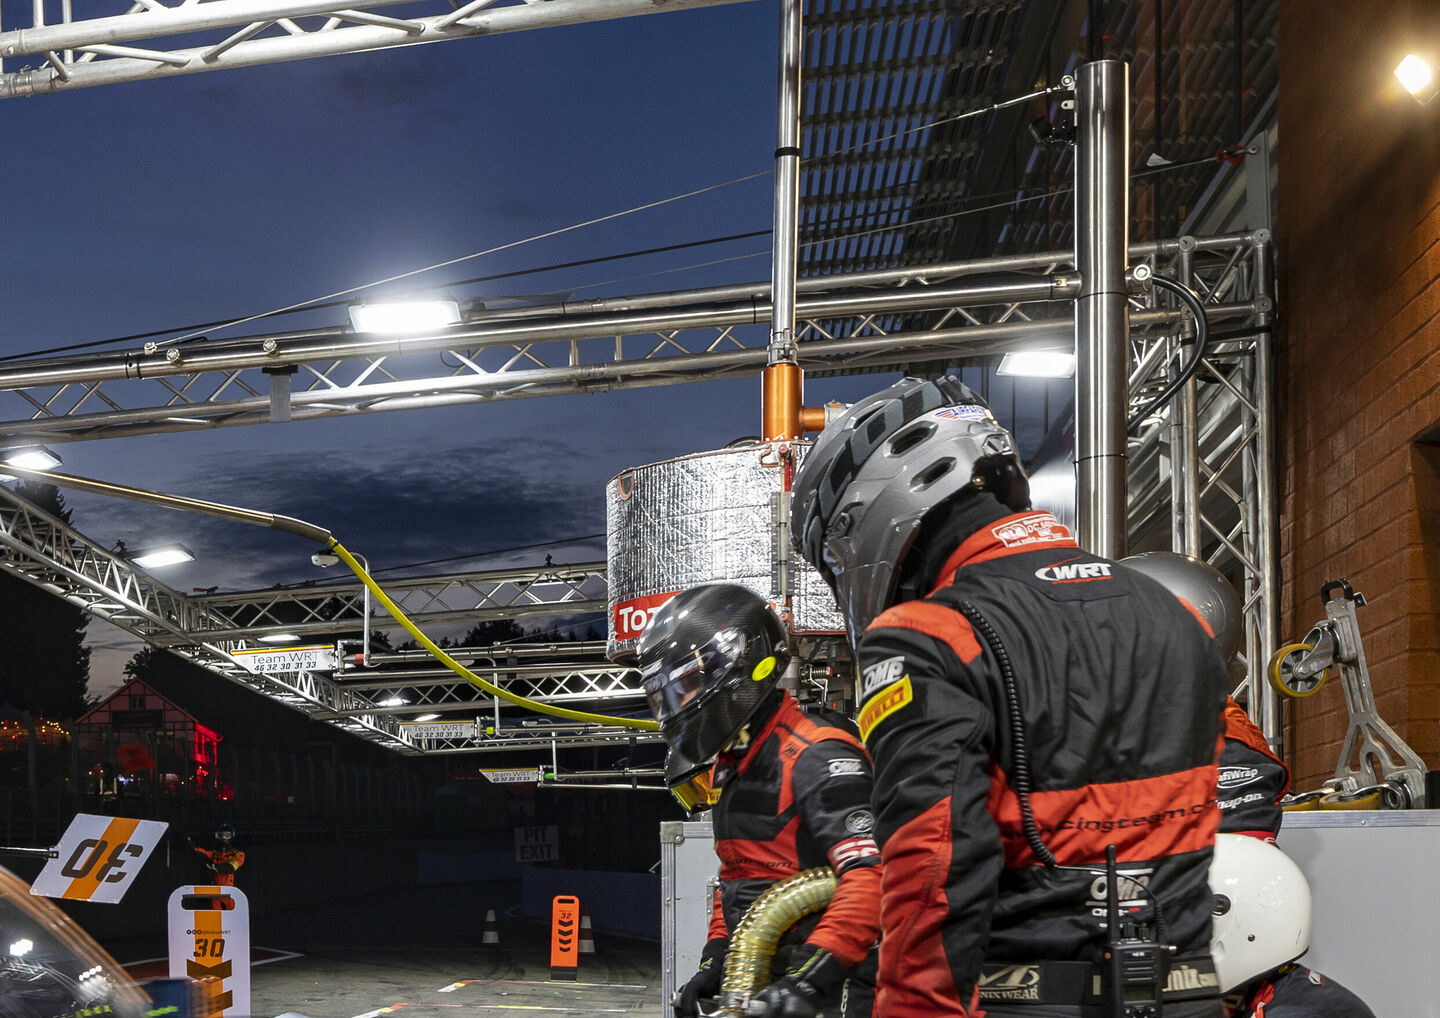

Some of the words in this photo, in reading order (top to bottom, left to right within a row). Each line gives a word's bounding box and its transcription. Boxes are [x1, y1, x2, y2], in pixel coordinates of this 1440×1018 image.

[1052, 562, 1112, 580] WRT
[251, 654, 286, 665] Team
[289, 651, 319, 662] WRT
[254, 664, 264, 672] 46
[267, 663, 277, 671] 32
[306, 661, 317, 669] 33
[864, 660, 904, 692] OMP
[524, 827, 548, 843] PIT
[60, 838, 144, 884] 30
[520, 844, 553, 861] EXIT
[193, 938, 226, 957] 30
[979, 991, 1001, 1000] NIX
[1002, 988, 1039, 1000] WEAR
